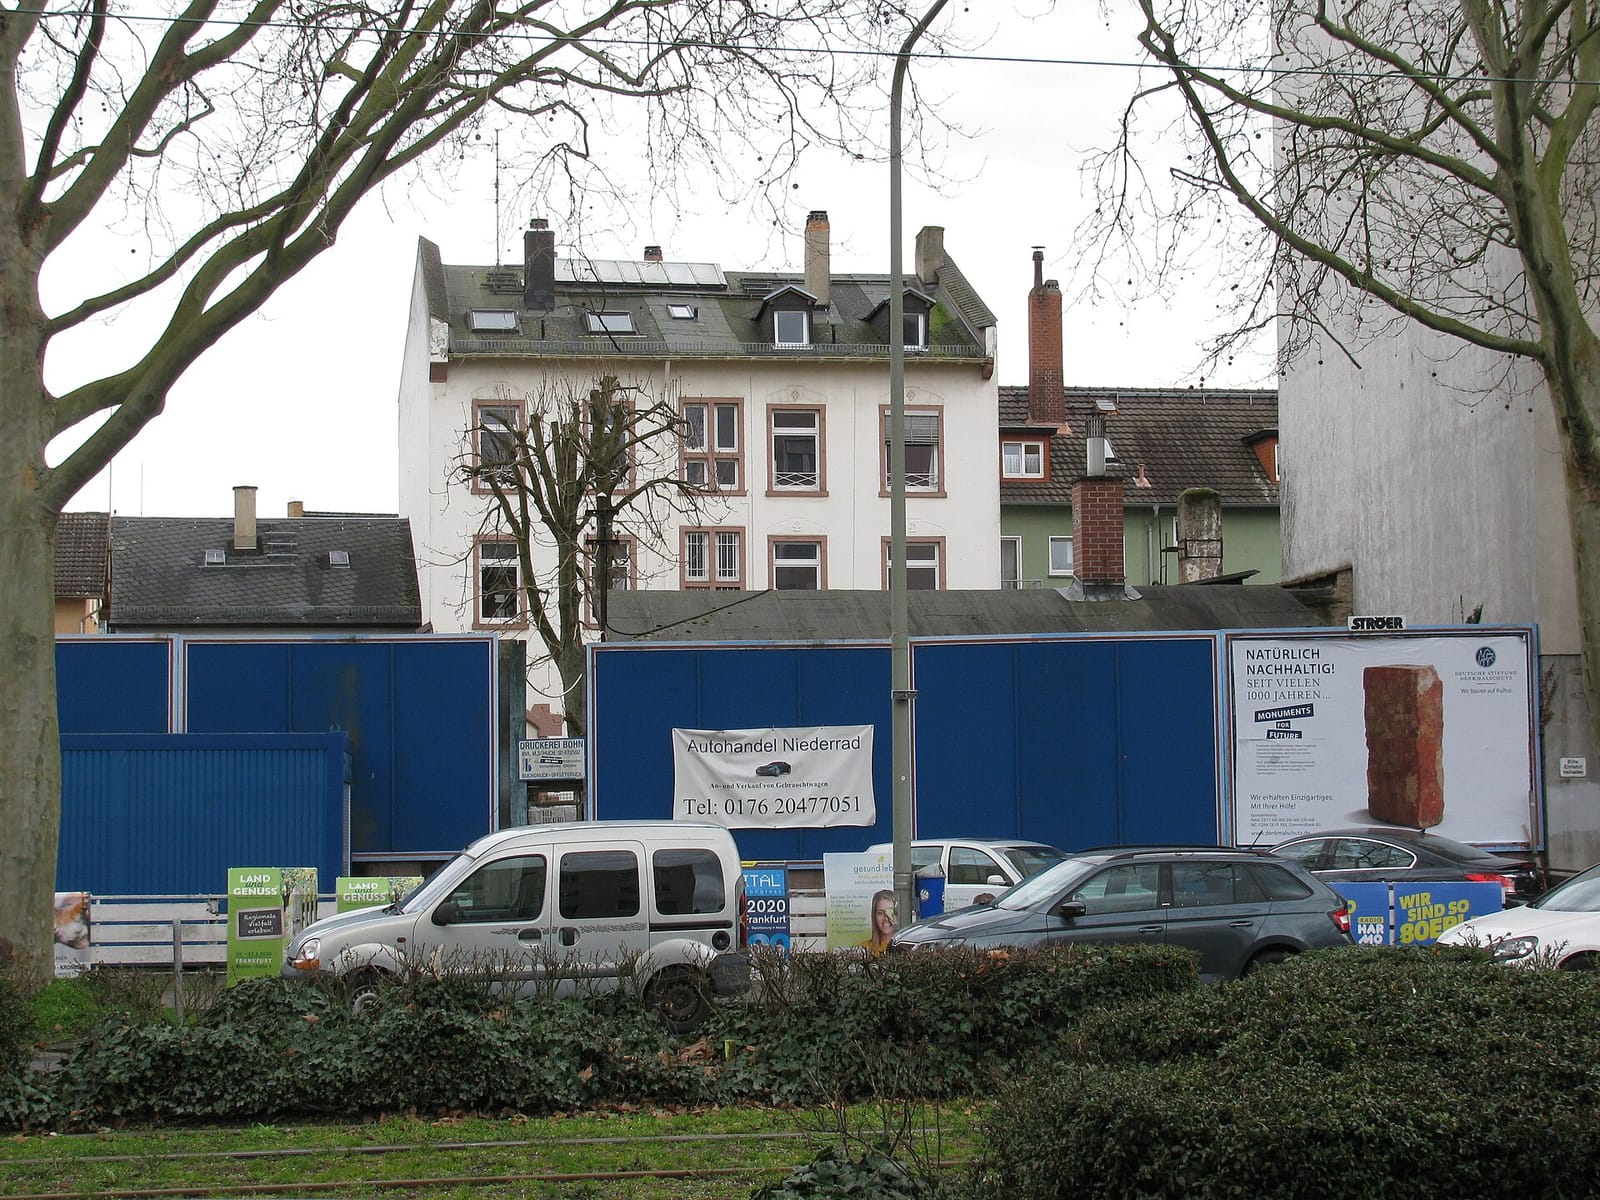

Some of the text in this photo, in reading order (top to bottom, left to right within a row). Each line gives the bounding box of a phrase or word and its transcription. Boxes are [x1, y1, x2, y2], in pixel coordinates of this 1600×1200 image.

[1351, 616, 1403, 630] STRÖER
[1246, 647, 1320, 660] NATÜRLICH
[1246, 664, 1335, 675] NACHHALTIG!
[1246, 678, 1320, 688] SEIT VIELEN
[1248, 691, 1270, 700] 1000
[1257, 706, 1311, 720] MONUMENTS
[520, 740, 584, 750] DRUCKEREI BOHN
[688, 736, 860, 753] Autohandel Niederrad
[1291, 794, 1334, 802] Einzigartiges.
[683, 796, 861, 815] Tel: 0176 20477051
[853, 864, 880, 874] gesund
[240, 874, 270, 883] LAND
[743, 874, 781, 887] ITAL
[233, 887, 278, 895] GENUSS
[343, 893, 386, 902] GENUSS
[1398, 892, 1431, 910] WIR
[747, 899, 786, 913] 2020
[1408, 899, 1470, 922] SIND SO
[747, 915, 786, 924] rankfurt
[1358, 924, 1384, 934] HAR
[1358, 934, 1383, 944] MO
